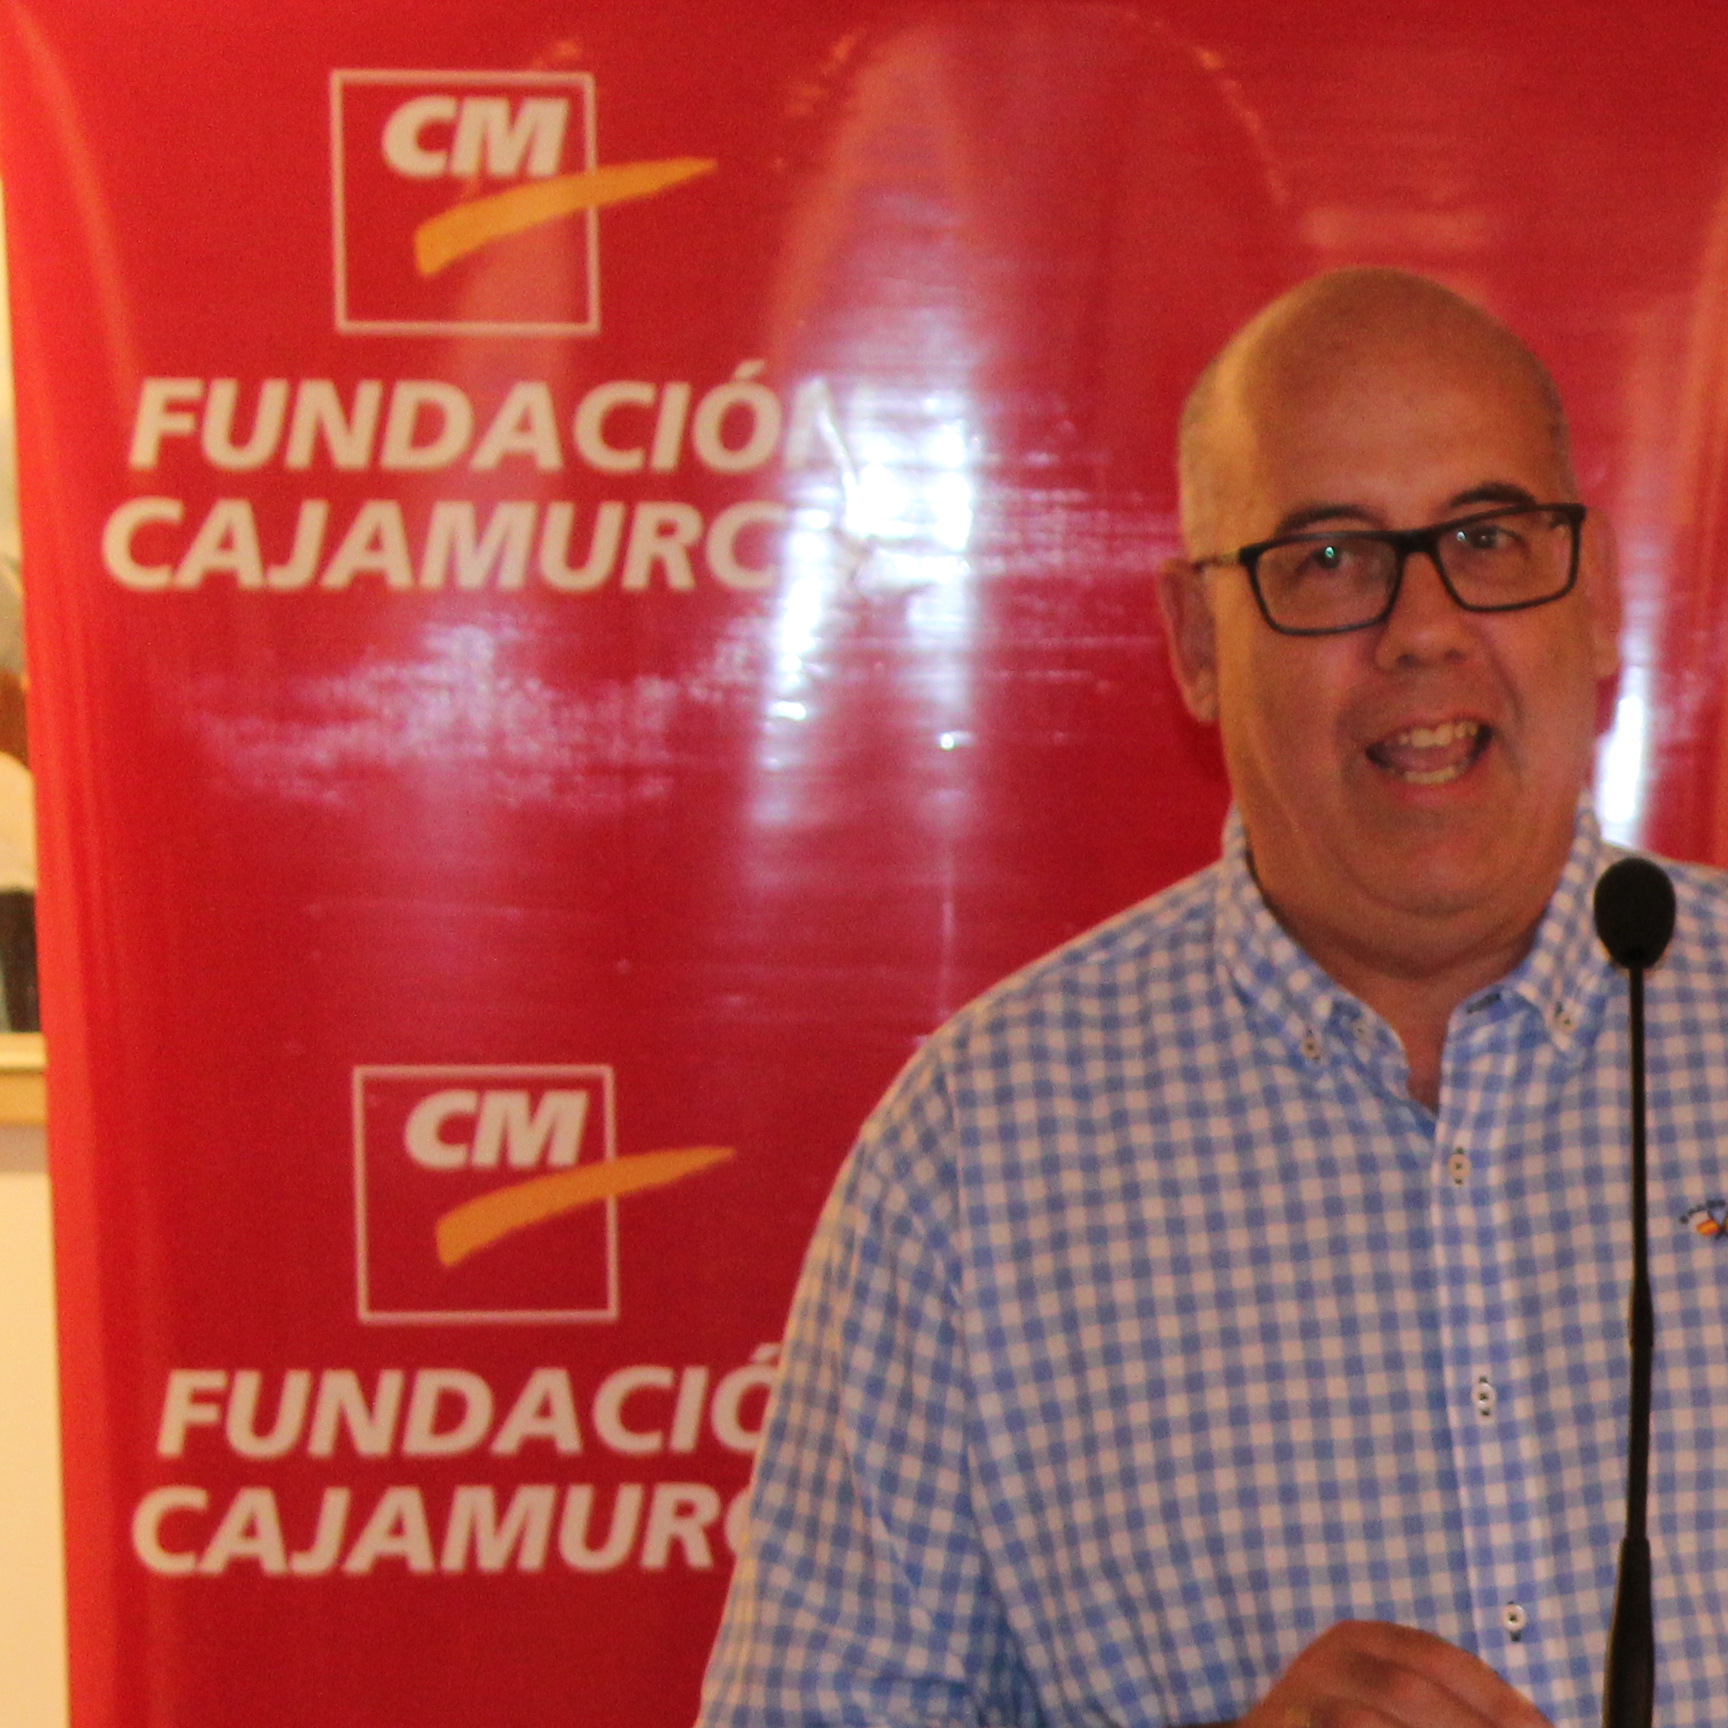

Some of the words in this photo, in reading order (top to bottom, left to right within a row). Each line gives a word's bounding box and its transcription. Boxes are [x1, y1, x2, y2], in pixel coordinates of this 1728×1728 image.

[381, 98, 569, 178] CM
[102, 498, 895, 592] CAJAMURC
[404, 1090, 589, 1169] CM
[157, 1342, 782, 1458] FUNDACIÓ
[131, 1484, 755, 1575] CAJAMUR
